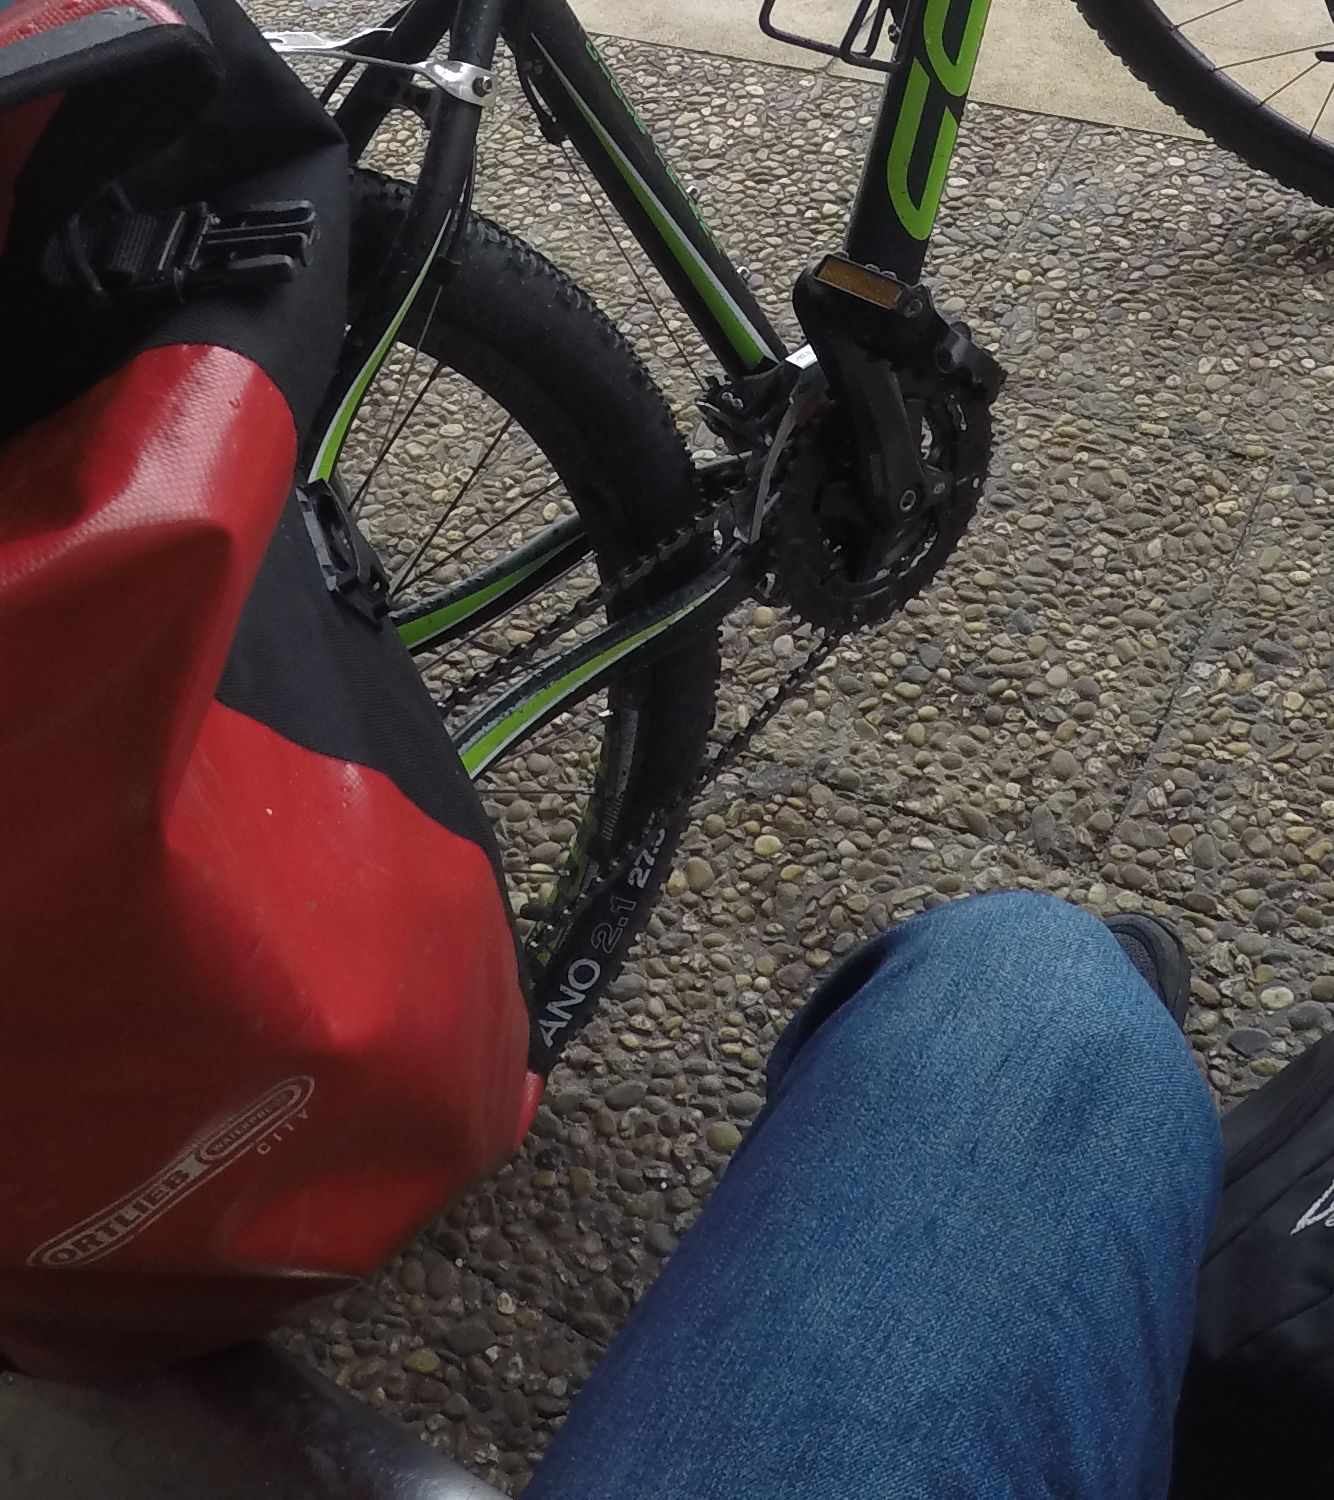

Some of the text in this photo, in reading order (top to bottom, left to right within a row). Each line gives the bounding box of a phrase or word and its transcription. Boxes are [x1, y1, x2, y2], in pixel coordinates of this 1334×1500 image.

[538, 957, 602, 1049] ANO
[590, 895, 638, 955] 2.1
[256, 1108, 310, 1156] CITY
[47, 1169, 192, 1265] ORTLIEB
